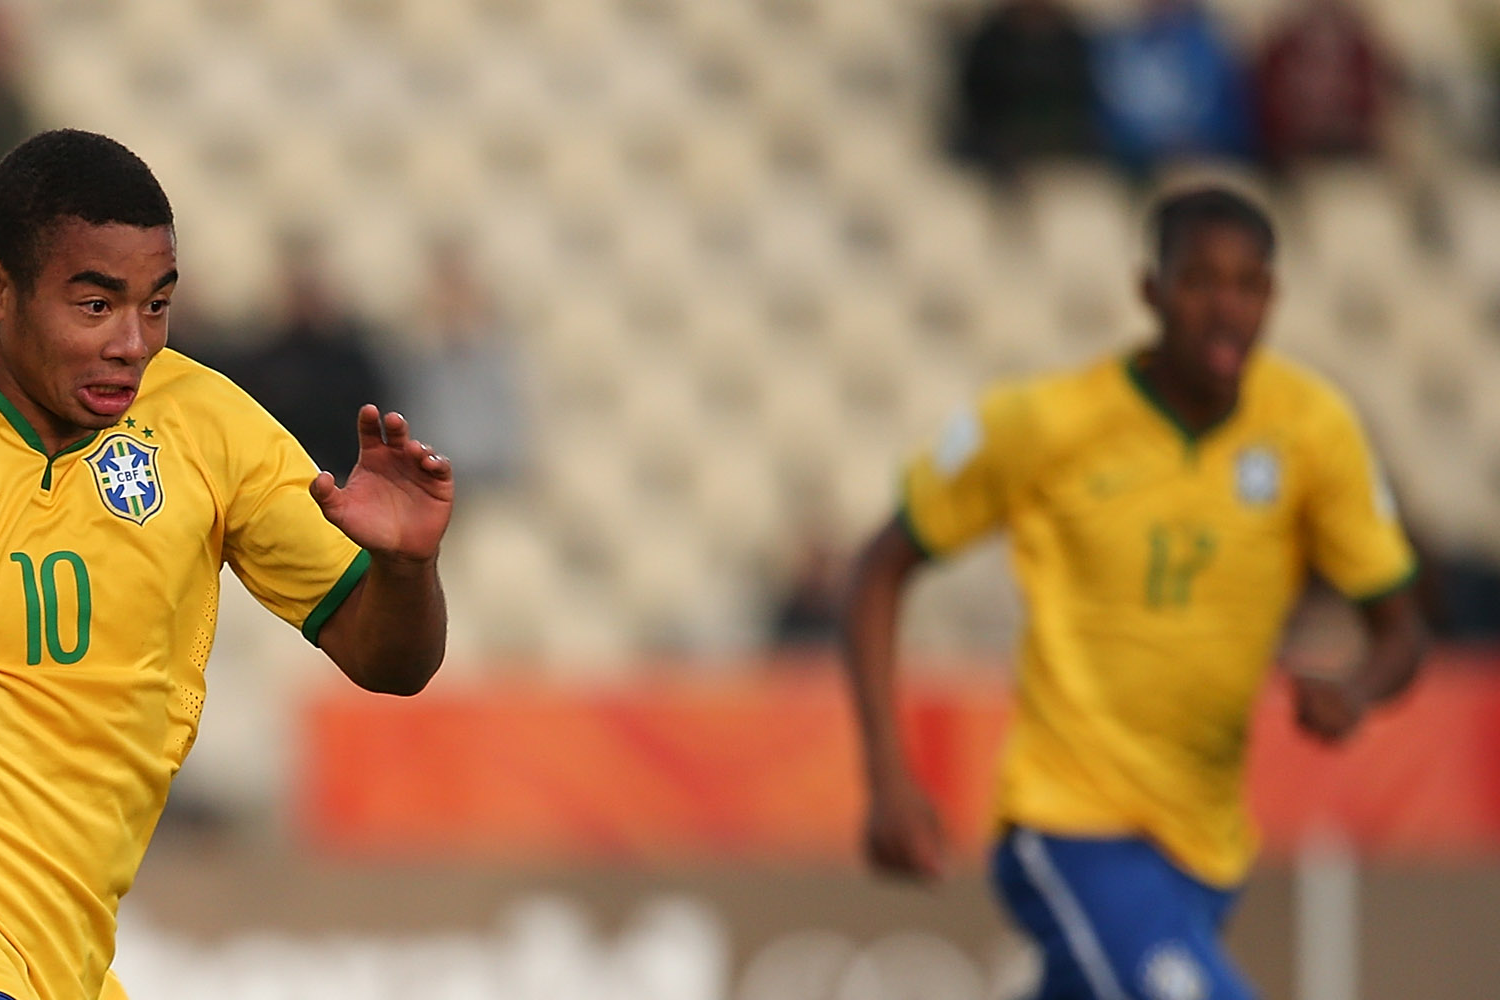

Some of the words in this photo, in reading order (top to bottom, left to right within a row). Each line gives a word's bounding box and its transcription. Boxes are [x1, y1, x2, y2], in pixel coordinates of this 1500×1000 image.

[116, 469, 139, 483] CBF
[10, 550, 92, 666] 10
[1144, 519, 1219, 611] 17
